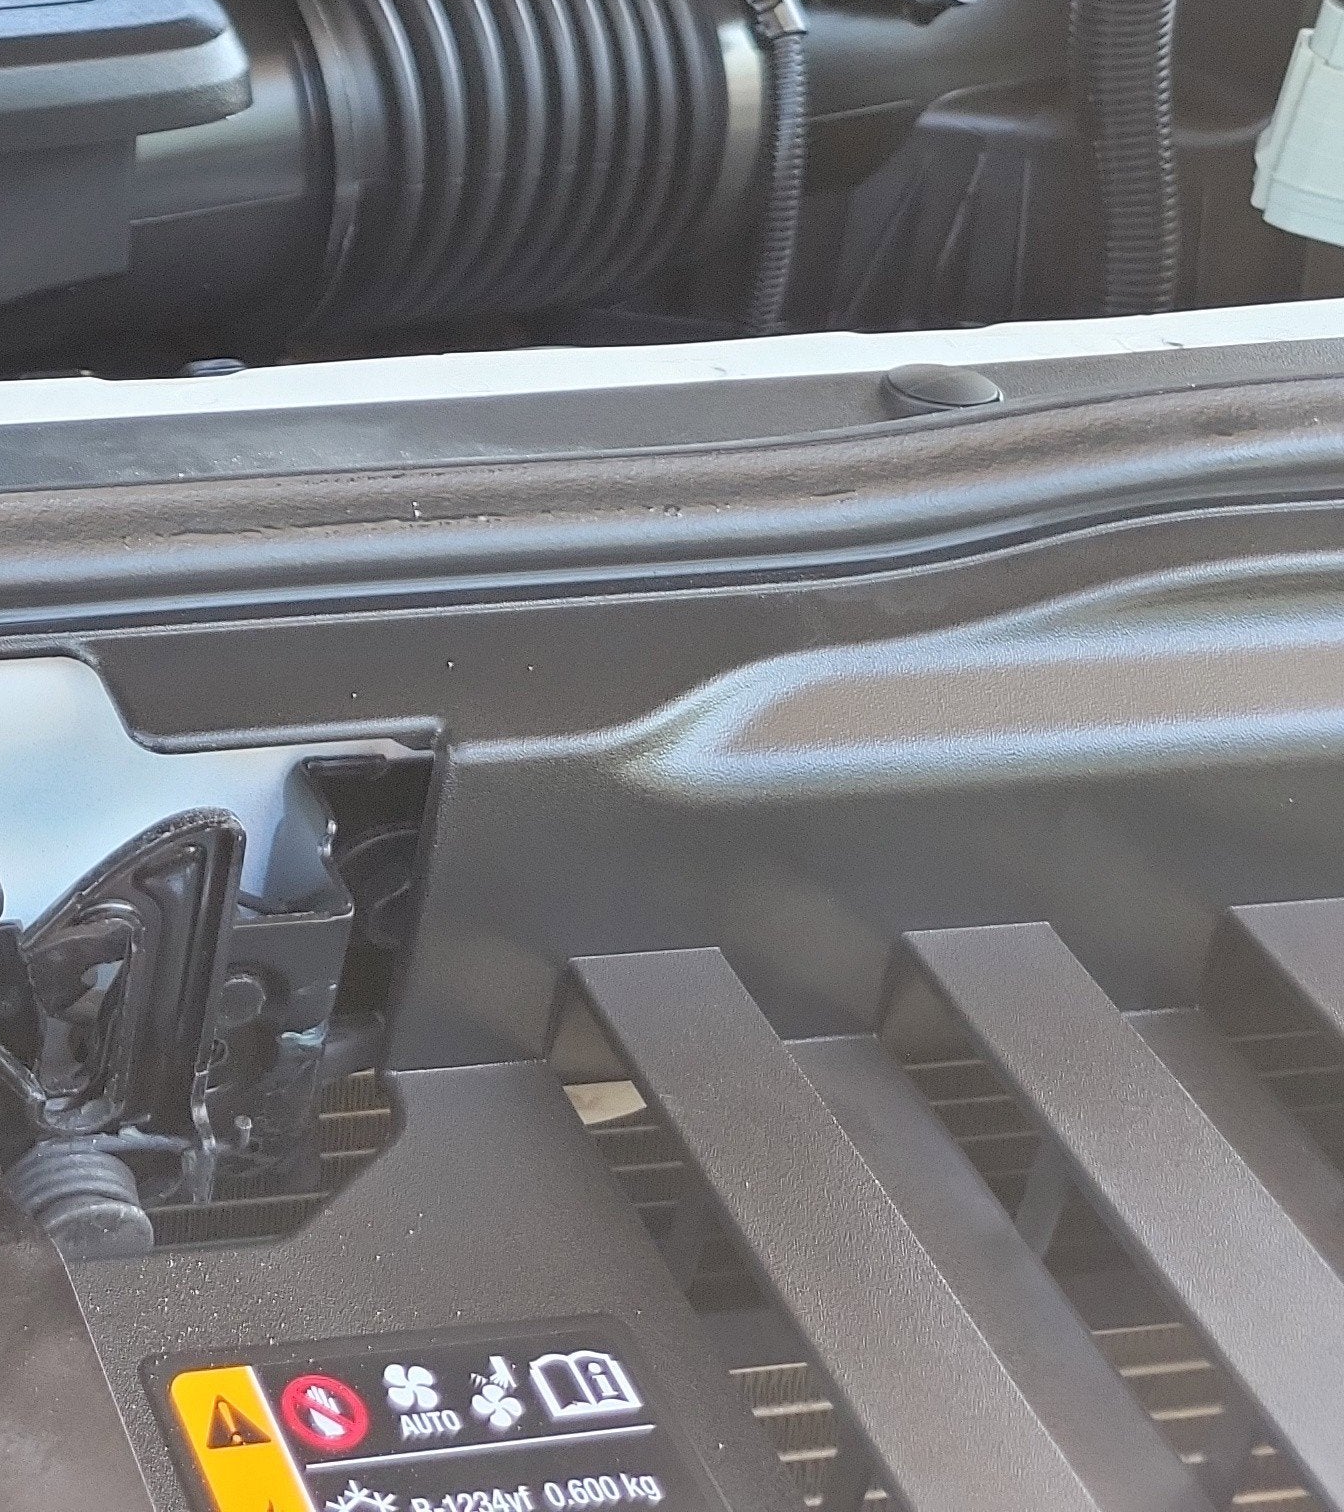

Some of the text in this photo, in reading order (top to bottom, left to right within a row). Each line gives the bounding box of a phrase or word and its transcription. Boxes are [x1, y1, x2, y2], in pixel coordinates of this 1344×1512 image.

[400, 1410, 460, 1436] AUTO
[543, 1476, 619, 1508] 0.600
[620, 1473, 663, 1502] kg
